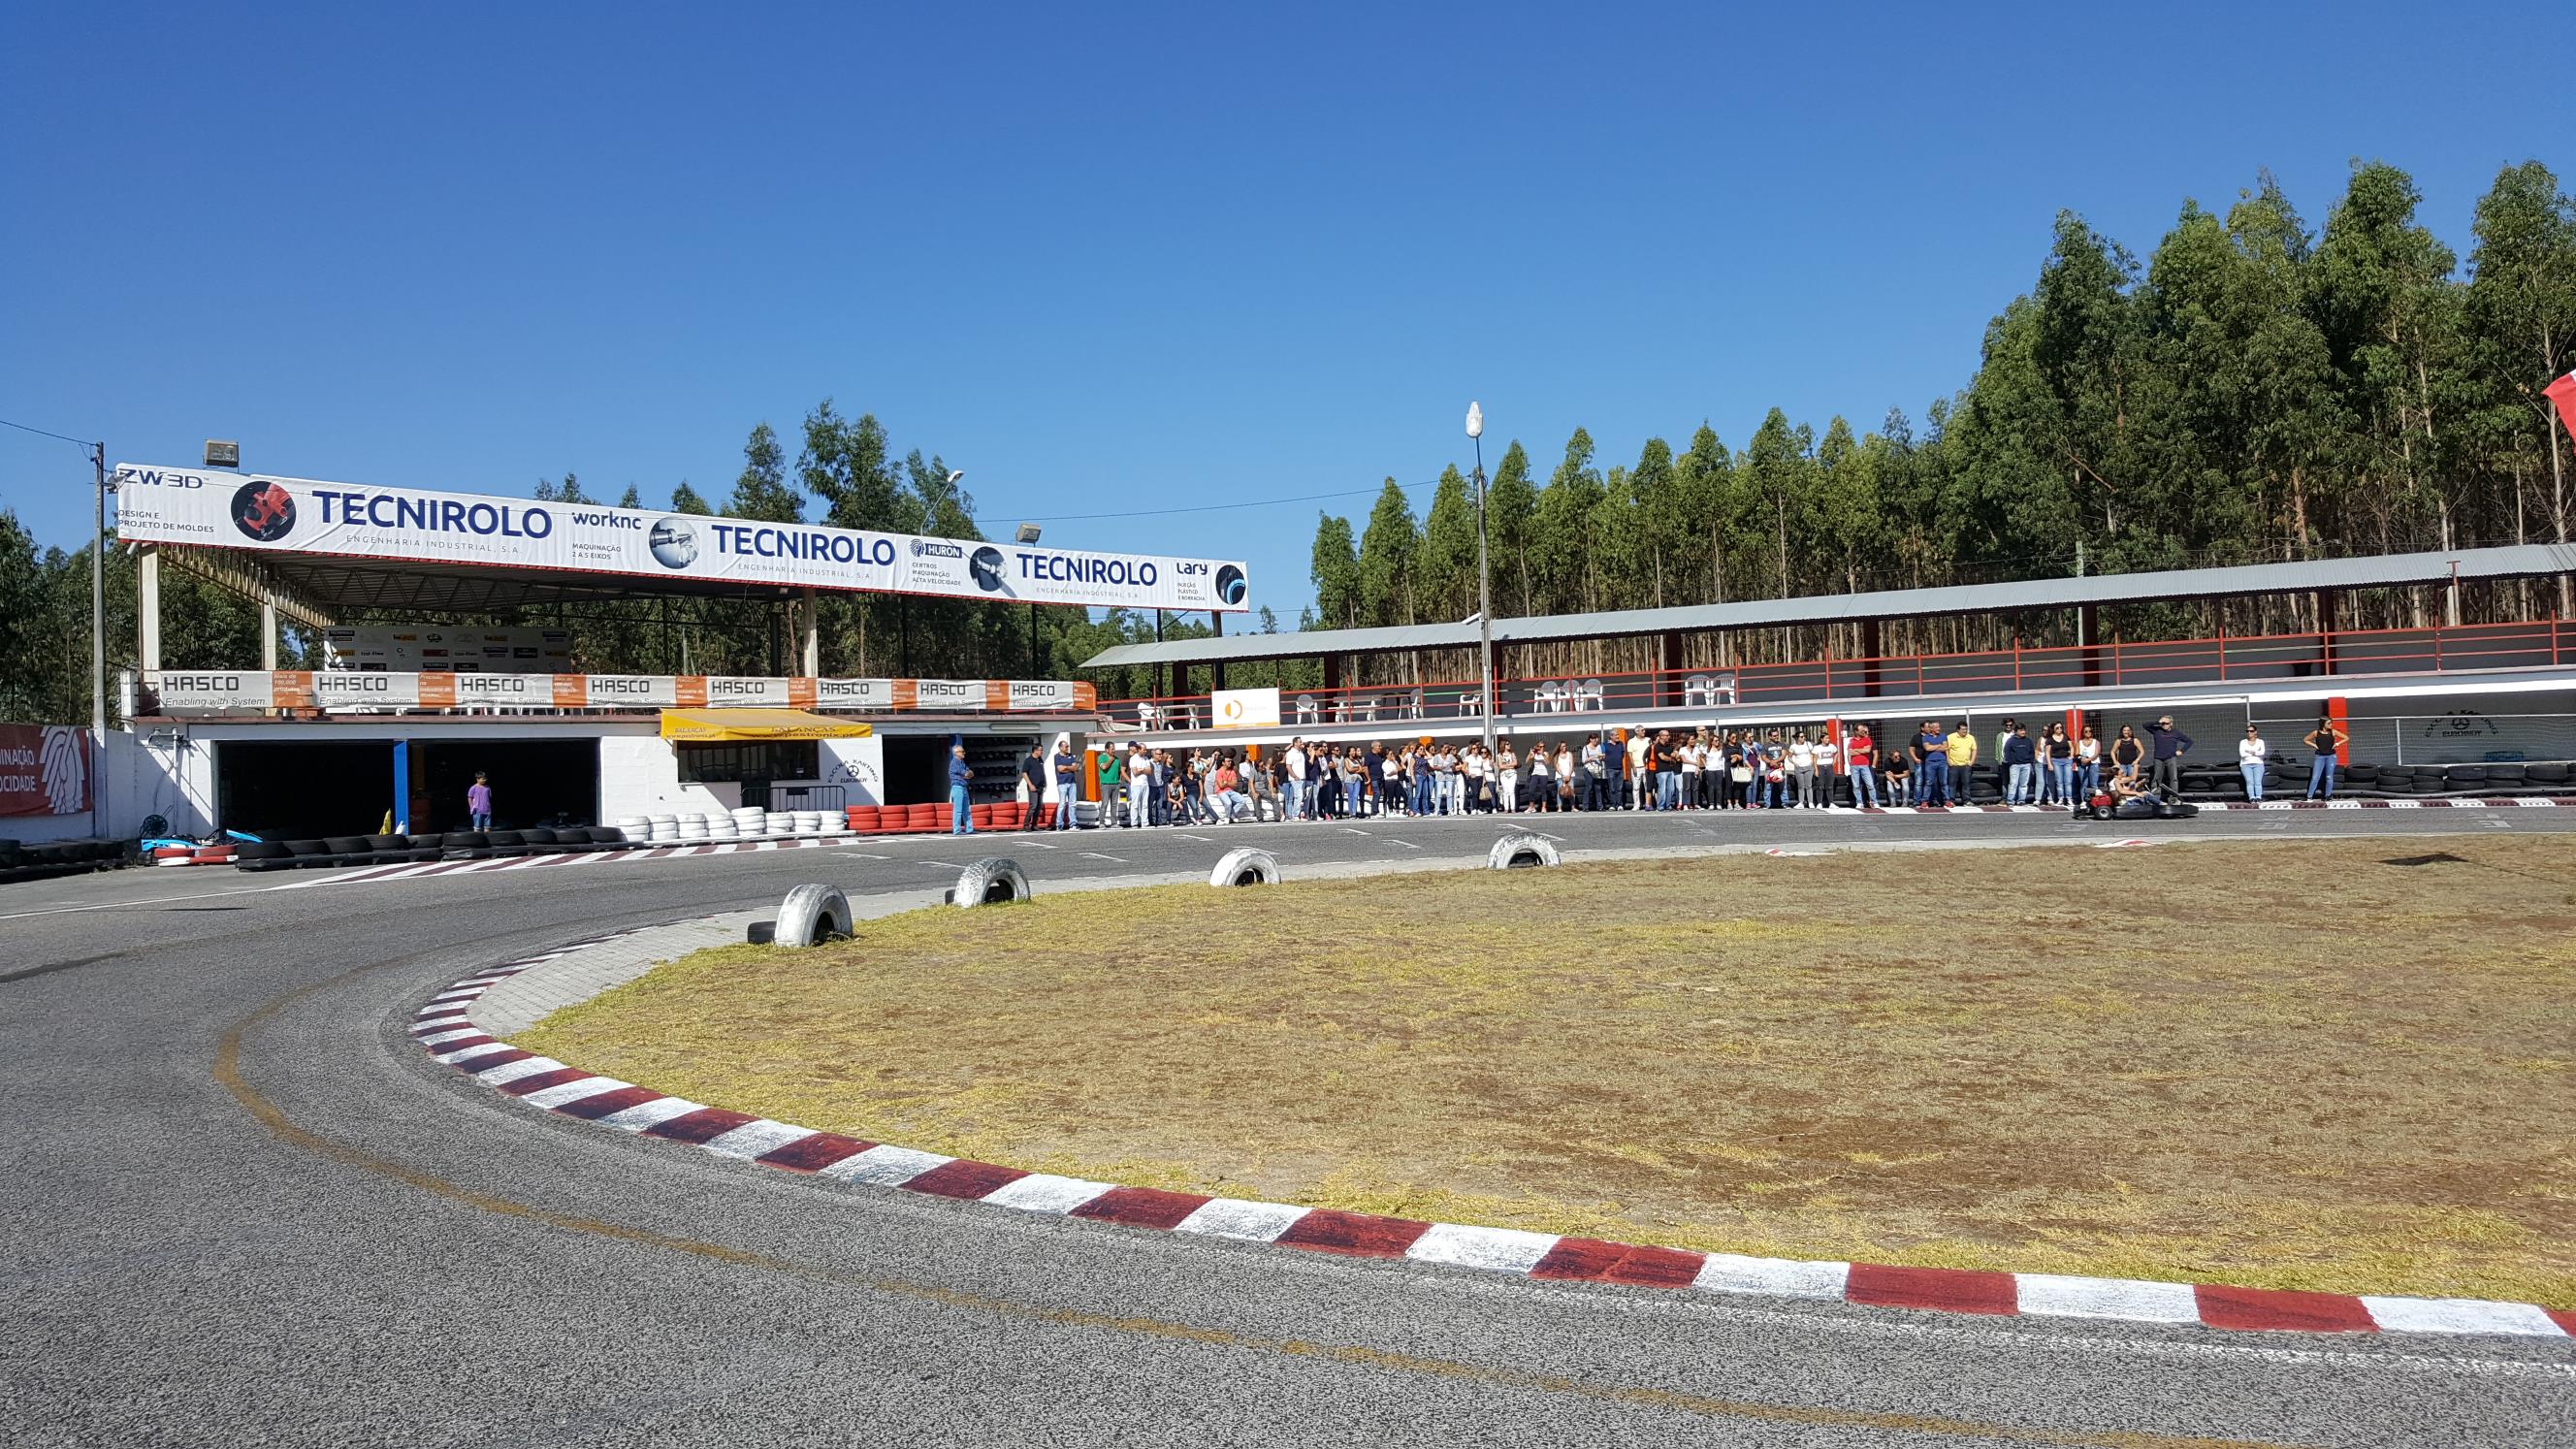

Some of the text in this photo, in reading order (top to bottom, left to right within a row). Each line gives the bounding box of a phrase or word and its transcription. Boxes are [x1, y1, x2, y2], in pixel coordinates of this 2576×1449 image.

[118, 509, 151, 519] DESIGN
[311, 490, 553, 539] TECNIROLO
[571, 510, 642, 531] worknc
[118, 519, 162, 530] PROJETO
[177, 524, 214, 533] MOLDES
[346, 534, 420, 547] ENGENHARIA
[711, 524, 896, 566] TECNIROLO
[572, 542, 622, 553] MAQUINAÇÃO
[928, 544, 960, 558] HURON
[738, 563, 796, 574] ENGENHARIA
[912, 569, 950, 579] MAQUINAÇÃO
[1015, 553, 1158, 587] TECNIROLO
[927, 577, 962, 587] VELOCIDADE
[164, 676, 240, 692] HASCO
[318, 676, 388, 692] HASCO
[461, 678, 525, 692] HASCO
[592, 679, 651, 693] HASCO
[711, 681, 765, 694] HASCO
[821, 682, 870, 695] HASCO
[920, 684, 966, 695] HASCO
[1013, 685, 1055, 696] HASCO
[165, 697, 207, 708] Enabling
[209, 697, 229, 706] with
[0, 745, 35, 770] INAÇÃO
